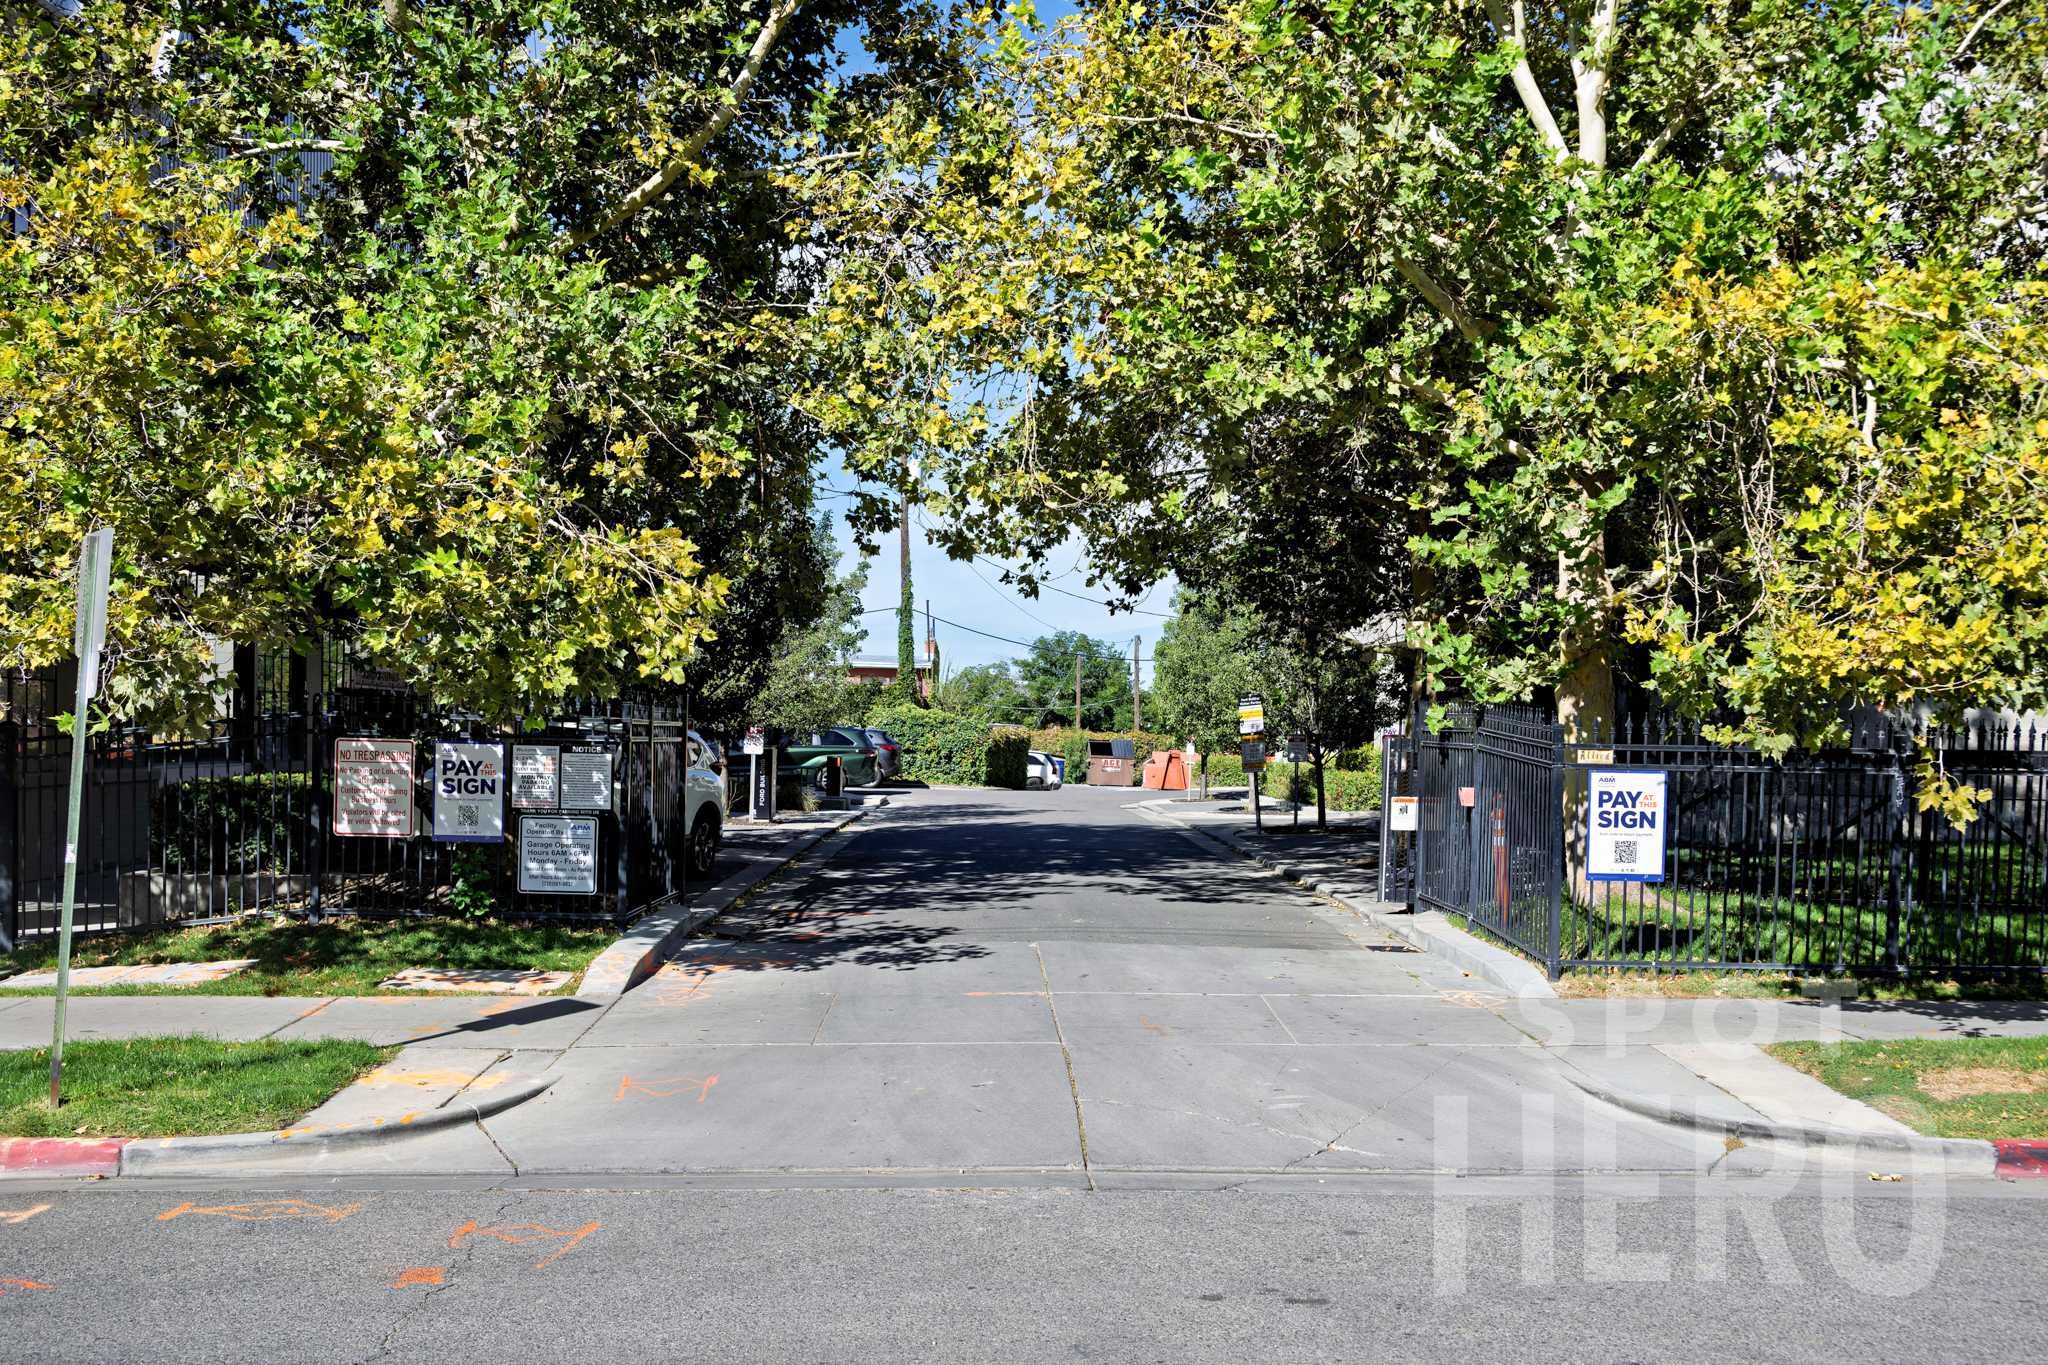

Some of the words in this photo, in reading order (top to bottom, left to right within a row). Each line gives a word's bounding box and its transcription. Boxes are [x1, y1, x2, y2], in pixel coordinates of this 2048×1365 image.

[572, 745, 602, 753] NOTICE
[340, 750, 351, 760] NO
[353, 750, 410, 761] TRESPASSING
[442, 759, 483, 776] PAY
[1598, 775, 1616, 783] ABM
[442, 777, 496, 795] SIGN
[1598, 790, 1643, 809] PAY
[1598, 810, 1656, 829] SIGN
[534, 822, 558, 830] Facility
[570, 823, 591, 831] ABM
[526, 840, 553, 849] Garage
[554, 841, 591, 850] Operating
[527, 848, 549, 856] Hours
[529, 857, 558, 865] Monday
[564, 857, 587, 866] Friday
